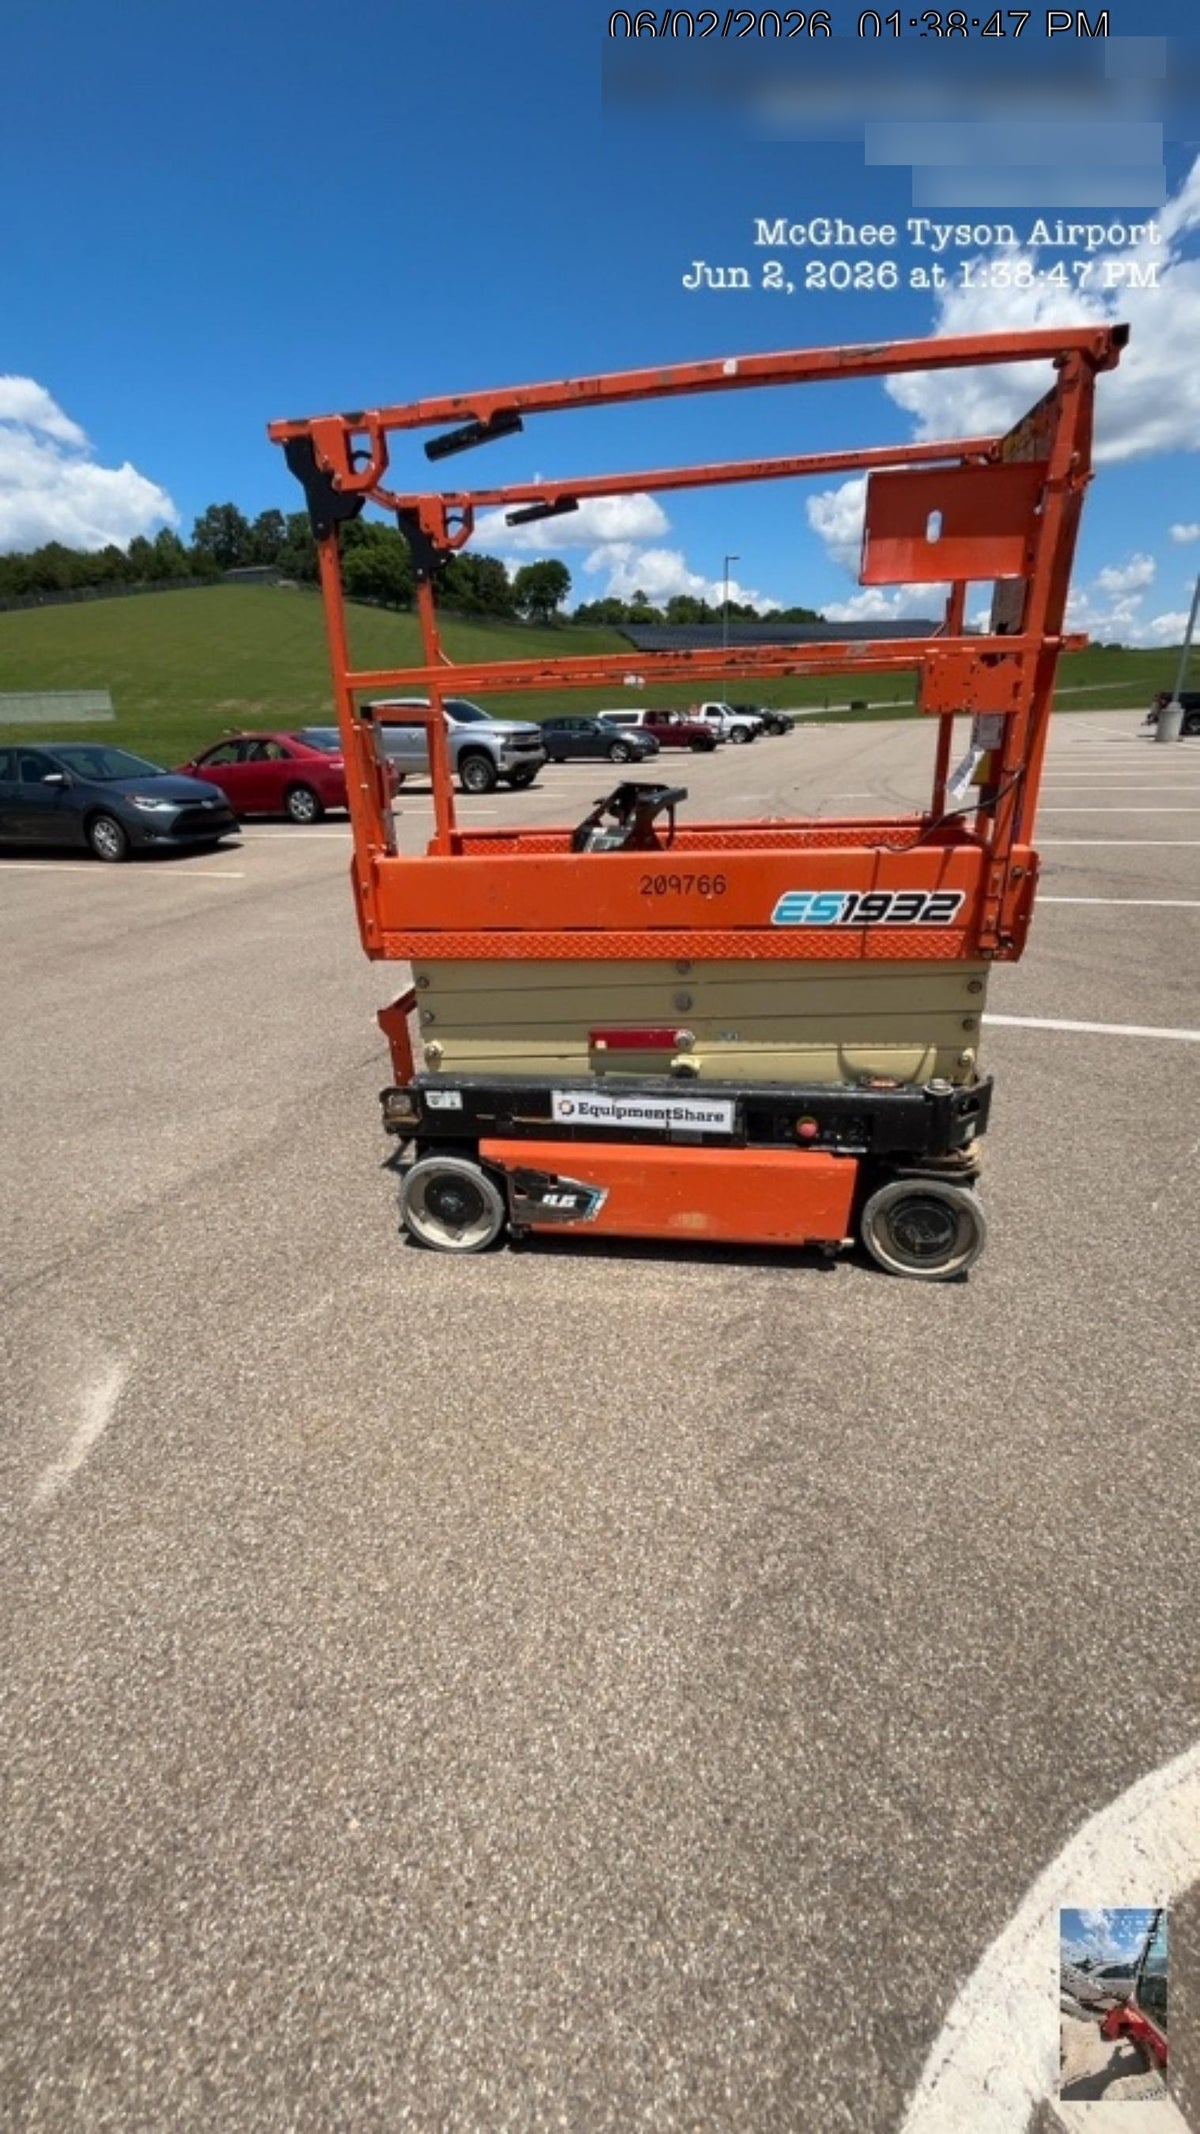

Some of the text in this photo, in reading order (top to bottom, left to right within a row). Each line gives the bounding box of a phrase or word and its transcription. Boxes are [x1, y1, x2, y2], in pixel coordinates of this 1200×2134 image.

[640, 874, 727, 896] 209766
[771, 890, 965, 925] ES1932
[578, 1102, 726, 1123] EquipmentShare
